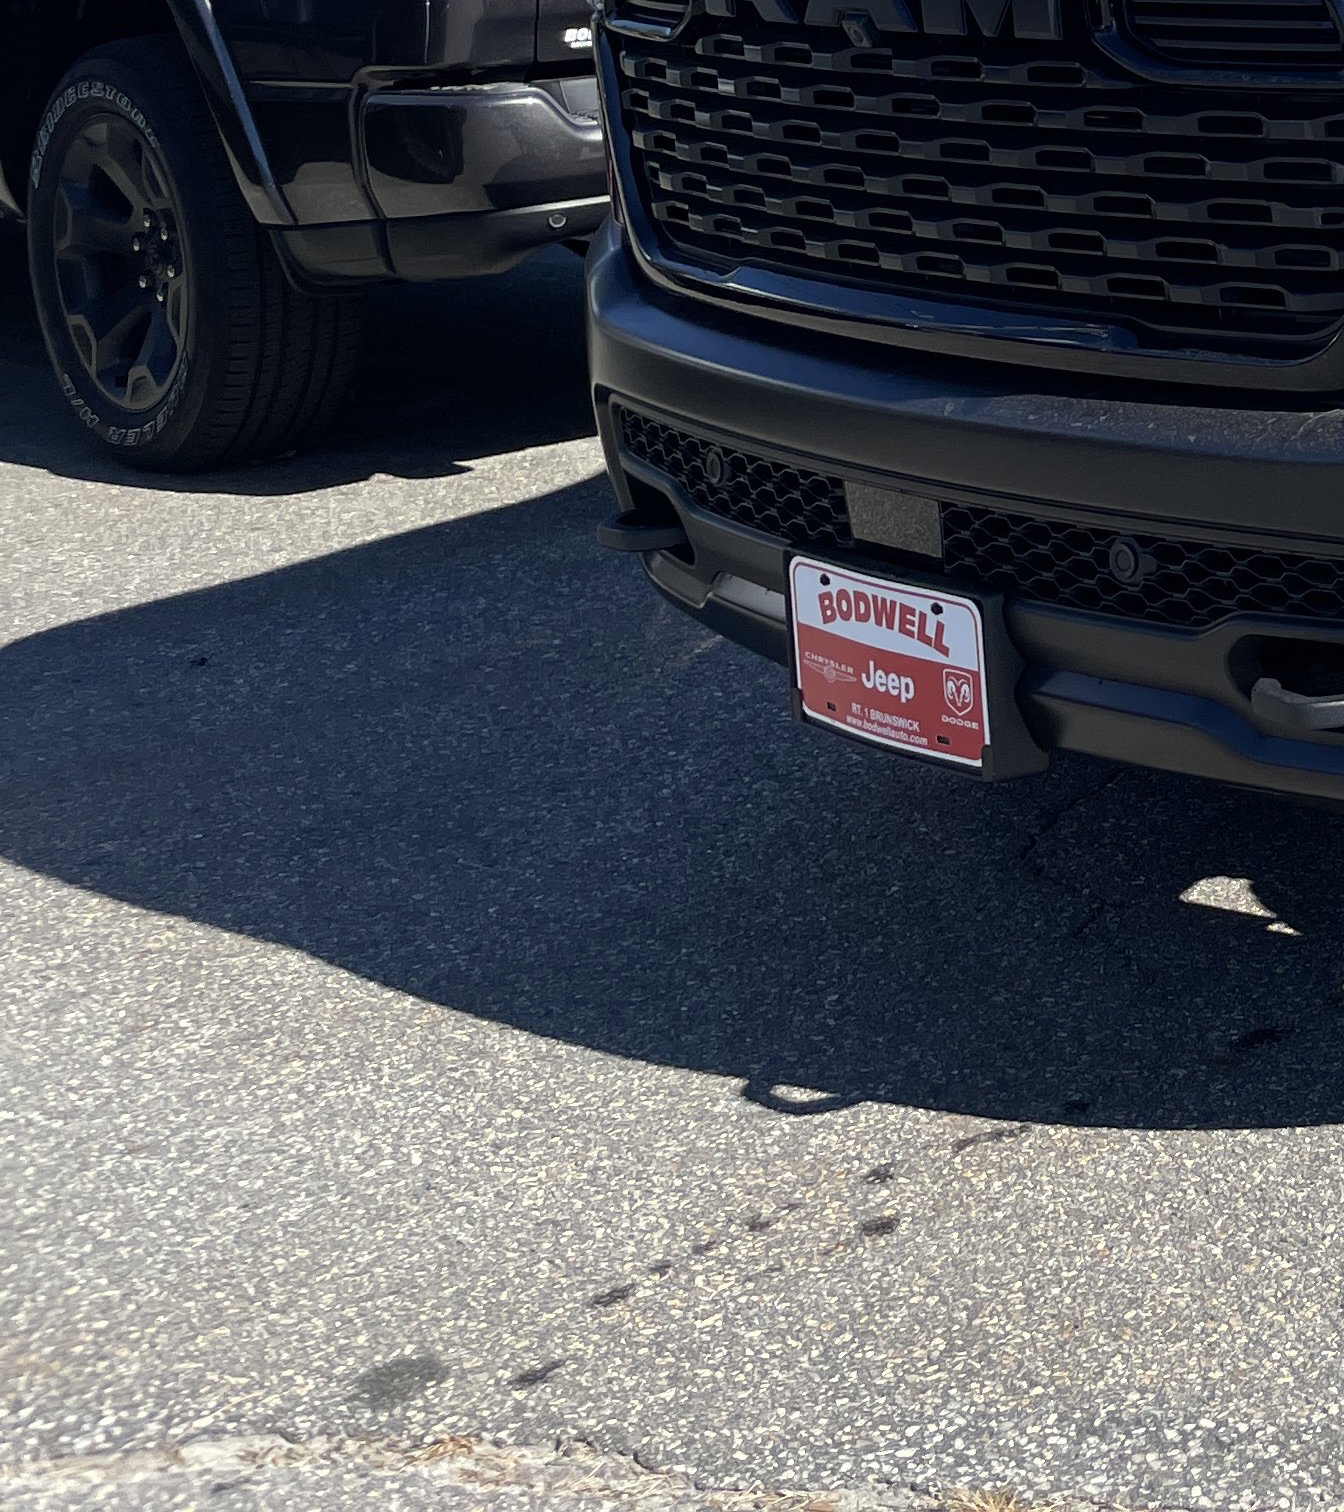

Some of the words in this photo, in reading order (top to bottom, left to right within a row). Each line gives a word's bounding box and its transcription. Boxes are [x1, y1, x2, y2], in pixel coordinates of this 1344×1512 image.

[817, 588, 951, 659] BODWELL
[804, 651, 854, 674] CHRYSLER
[861, 660, 915, 703] Jeep
[846, 715, 928, 746] www.bodwellauto.com
[870, 709, 920, 732] BRUNSWICK
[941, 714, 979, 730] DODGE
